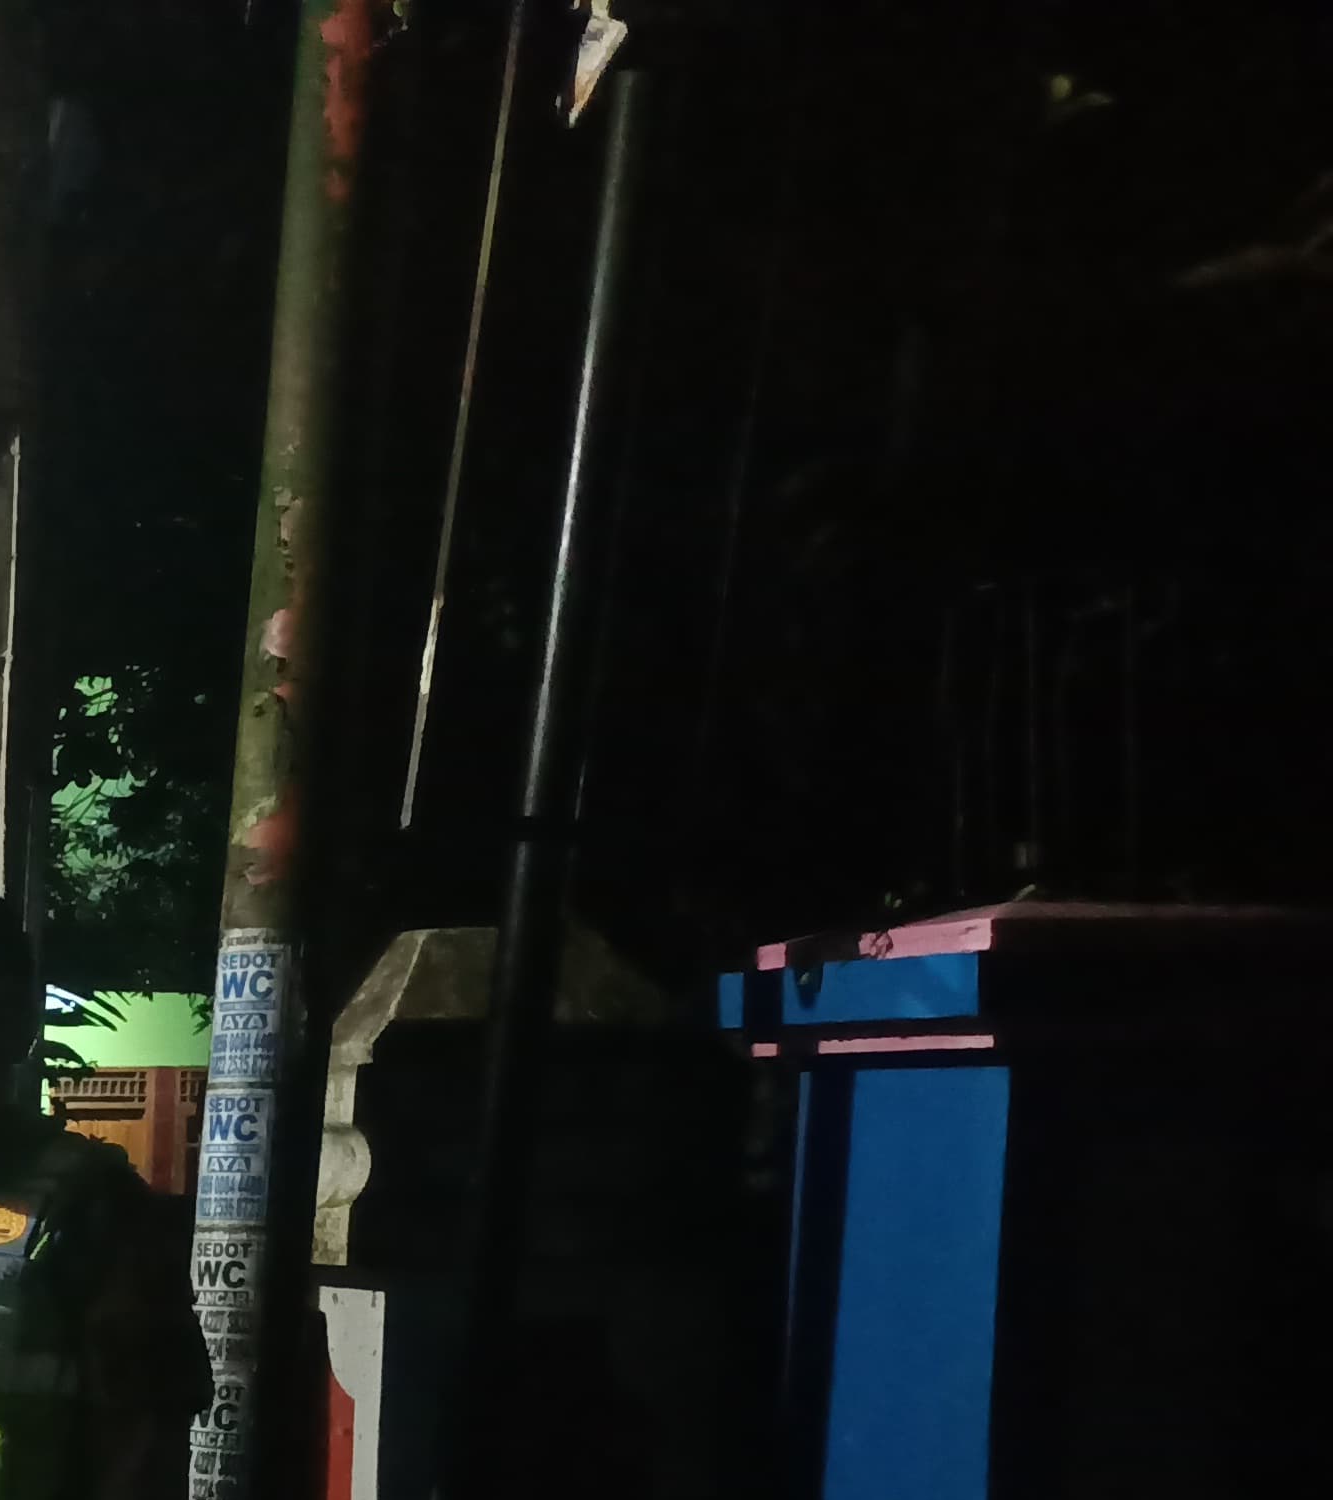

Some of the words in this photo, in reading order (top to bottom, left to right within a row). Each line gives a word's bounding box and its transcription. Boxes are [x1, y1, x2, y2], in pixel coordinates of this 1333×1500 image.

[220, 952, 278, 970] SEDOT
[221, 970, 274, 1000] WC
[208, 1097, 262, 1114] SEDOT
[209, 1114, 259, 1142] WC
[196, 1242, 252, 1258] SEDOT
[197, 1260, 246, 1288] WC
